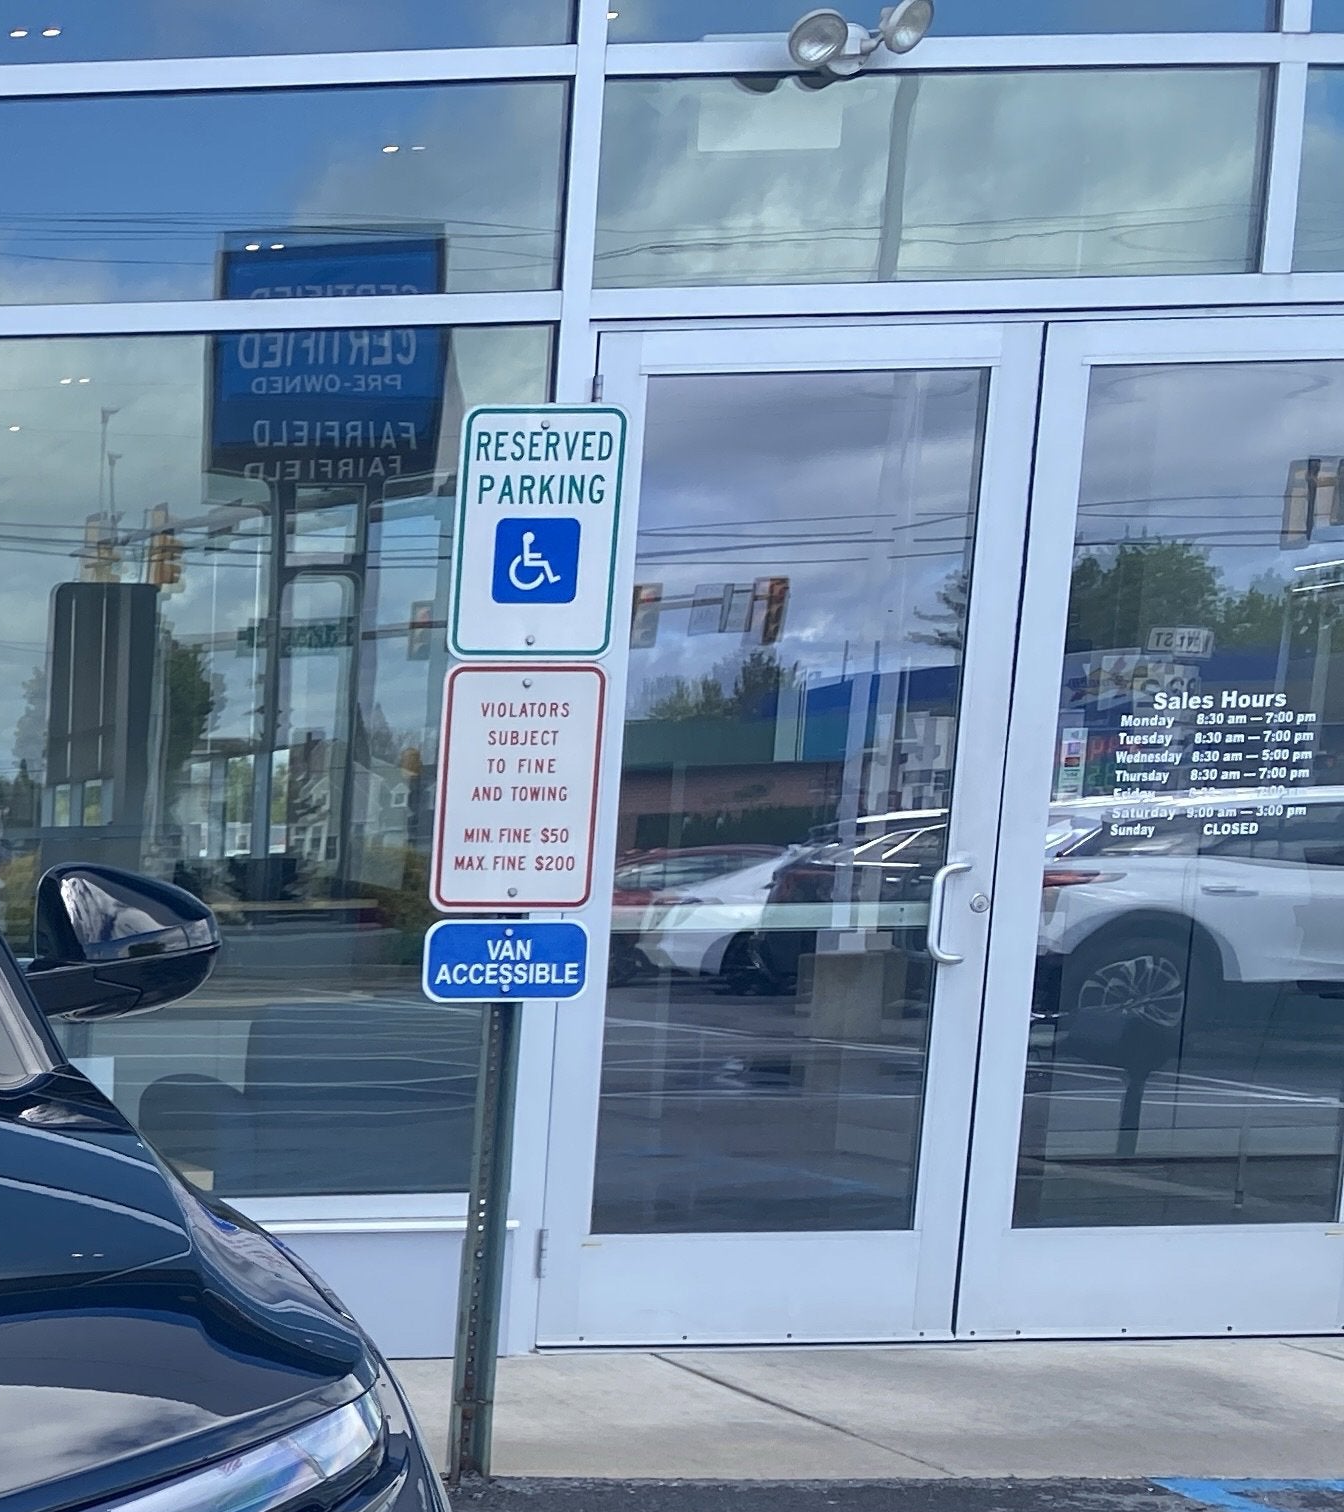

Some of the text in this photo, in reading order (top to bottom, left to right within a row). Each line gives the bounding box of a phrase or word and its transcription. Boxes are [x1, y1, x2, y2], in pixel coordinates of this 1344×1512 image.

[476, 431, 613, 461] RESERVED
[478, 474, 605, 504] PARKING
[1153, 690, 1287, 710] Sales Hours
[481, 702, 570, 718] VIOLATORS
[1121, 714, 1175, 728] Monday
[1196, 713, 1224, 724] 8:30
[1227, 714, 1247, 724] am
[1265, 711, 1293, 723] 7:00
[1296, 713, 1316, 725] pm
[488, 731, 559, 746] SUBJECT
[1118, 732, 1173, 746] Tuesday
[1194, 732, 1222, 743] 8:30
[1225, 733, 1245, 743] am
[1263, 730, 1291, 742] 7:00
[1294, 732, 1314, 744] pm
[1116, 750, 1183, 765] Wednesday
[1192, 750, 1219, 762] 8:30
[1222, 752, 1243, 761] am
[1262, 749, 1289, 760] 5:00
[1292, 750, 1312, 762] pm
[488, 759, 556, 773] TO FINE
[1115, 770, 1169, 784] Thursday
[1190, 769, 1217, 780] 8:30
[1220, 770, 1240, 780] am
[1259, 767, 1287, 779] 7:00
[1289, 769, 1310, 780] pm
[472, 787, 568, 802] AND TOWING
[1111, 806, 1176, 820] Saturday
[1217, 808, 1237, 818] am
[1255, 805, 1284, 817] 3:00
[1286, 806, 1307, 818] pm
[499, 828, 531, 843] FINE
[540, 827, 569, 844] $50
[1110, 823, 1259, 838] Sunday CLOSED
[493, 856, 526, 871] FINE
[535, 856, 575, 871] $200
[487, 939, 532, 960] VAN
[435, 963, 579, 985] ACCESSIBLE
